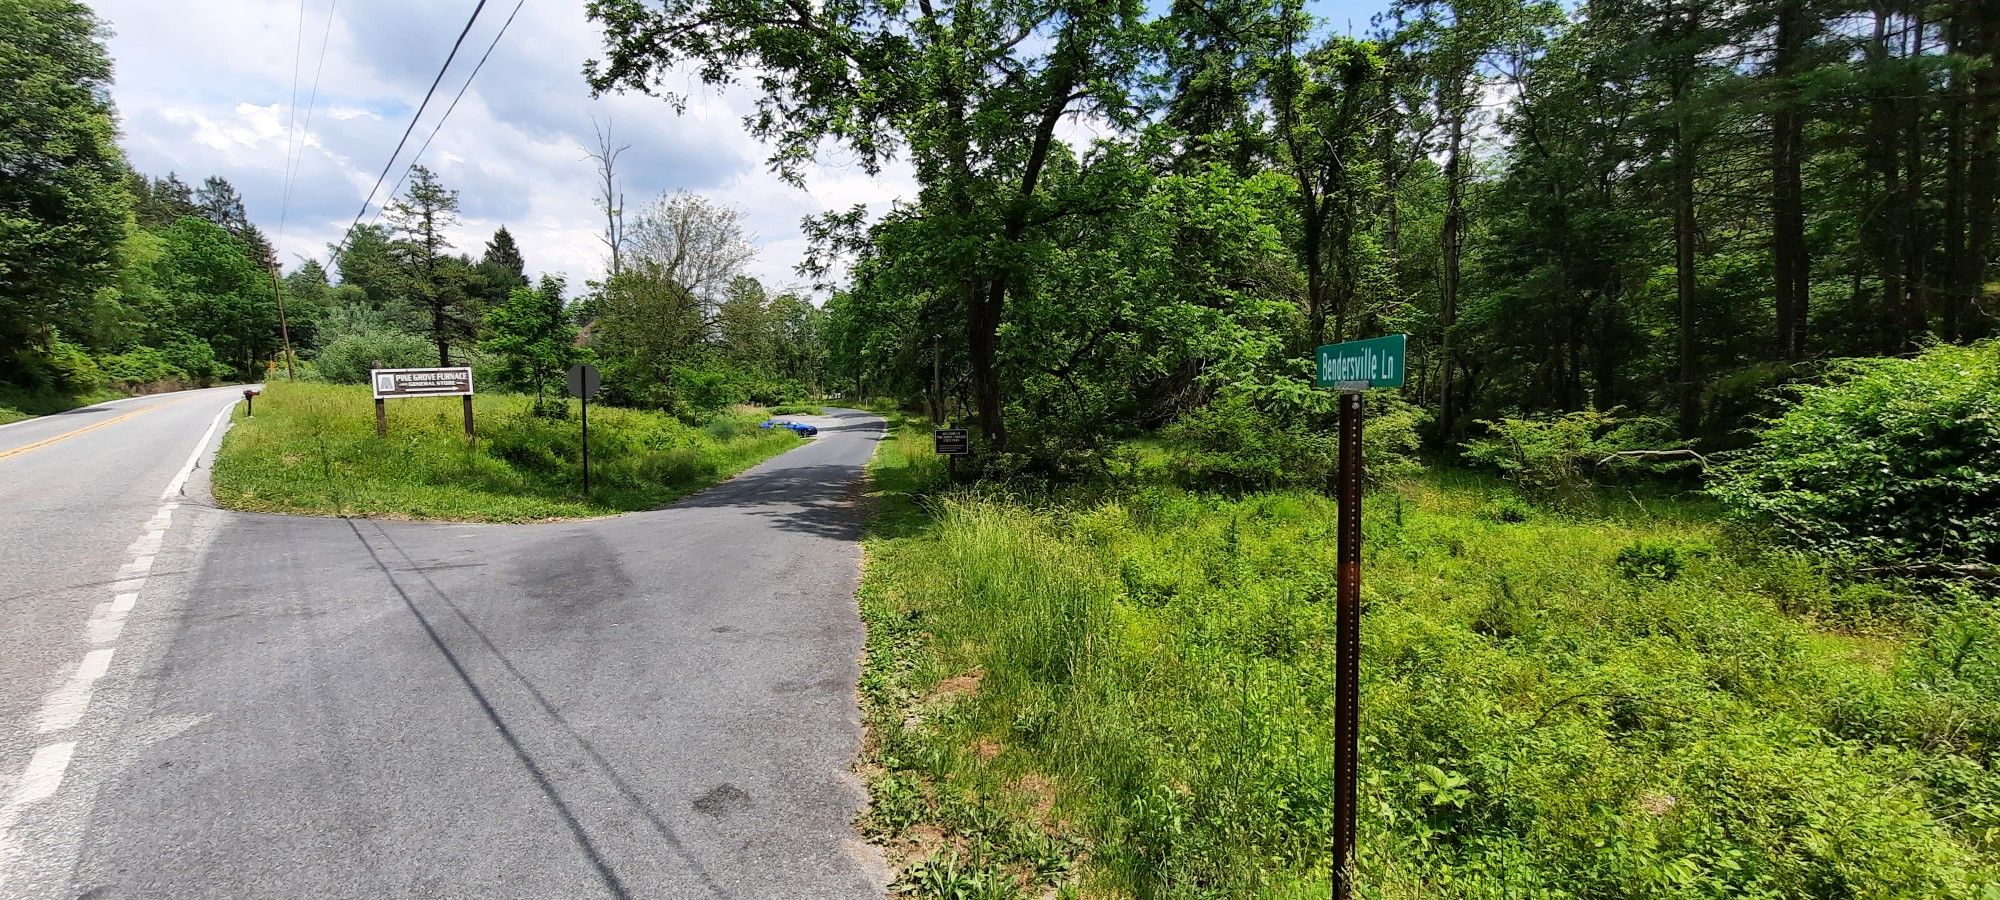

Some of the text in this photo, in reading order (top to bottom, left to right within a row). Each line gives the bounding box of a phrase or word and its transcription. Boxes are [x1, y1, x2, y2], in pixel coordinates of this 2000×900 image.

[1322, 346, 1394, 381] Bendersville Ln
[395, 372, 467, 382] PINE GROVE FURNACE
